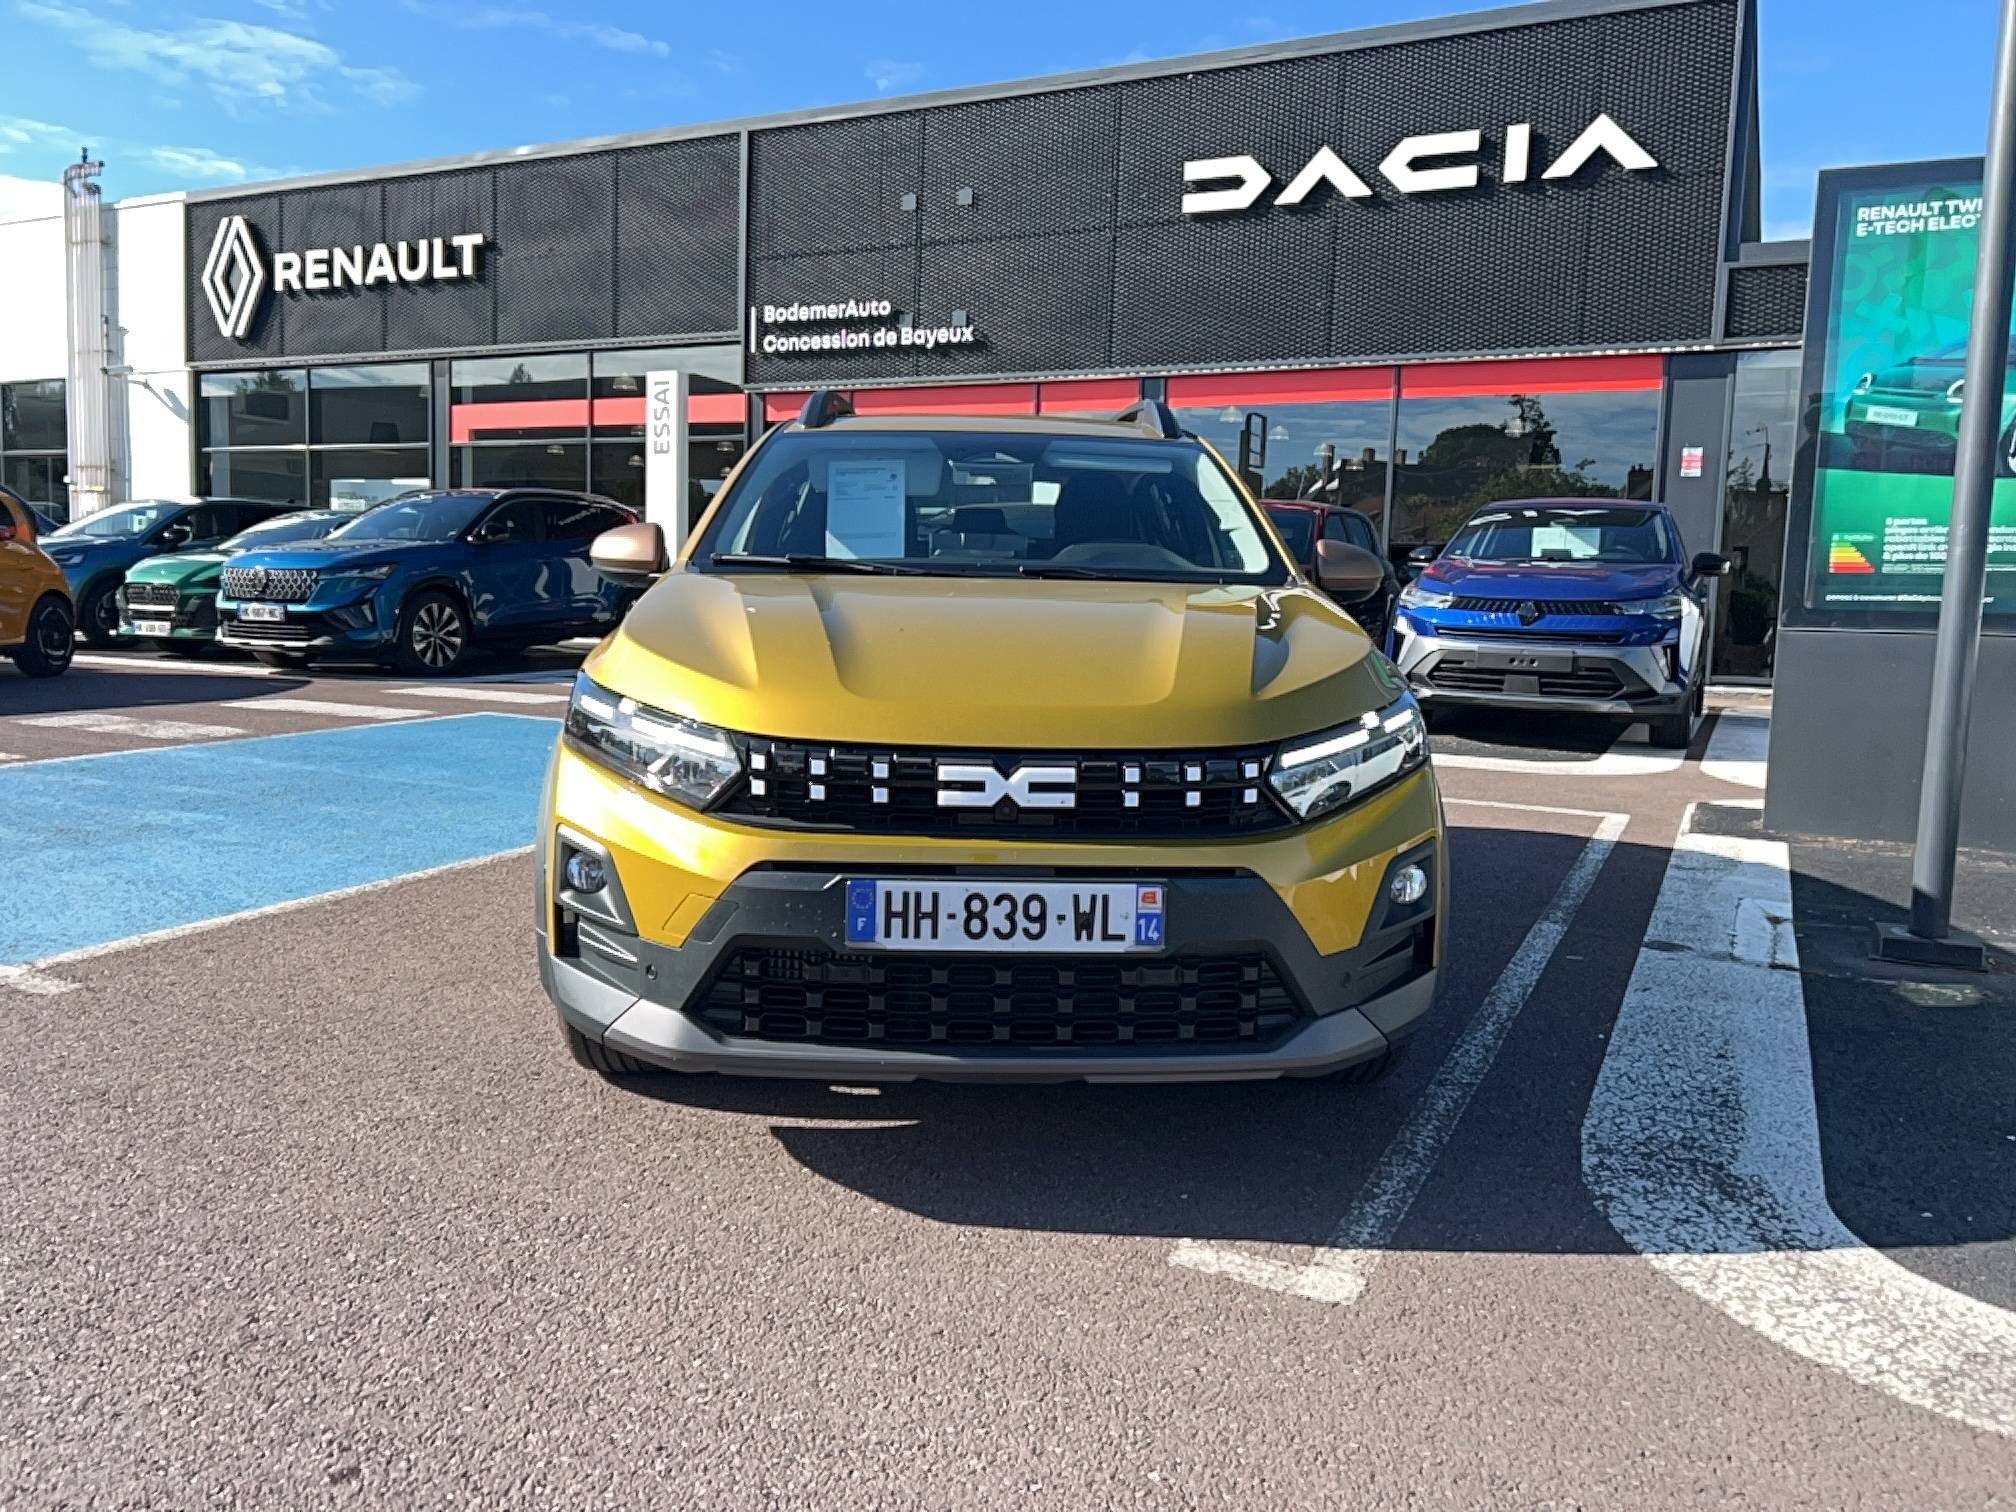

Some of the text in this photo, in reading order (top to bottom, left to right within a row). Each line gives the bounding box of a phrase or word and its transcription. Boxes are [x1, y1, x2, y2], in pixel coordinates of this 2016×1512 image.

[1182, 112, 1659, 214] DACIA
[1856, 201, 1944, 222] RENAULT
[1856, 217, 1925, 237] E-TECH
[273, 232, 484, 292] RENAULT
[763, 300, 891, 323] BodemerAuto
[763, 325, 974, 353] Concession de Bayeux
[653, 380, 671, 455] ESSAI
[856, 917, 867, 932] F
[884, 890, 1126, 942] HH-839-WL
[1137, 918, 1160, 941] 14
